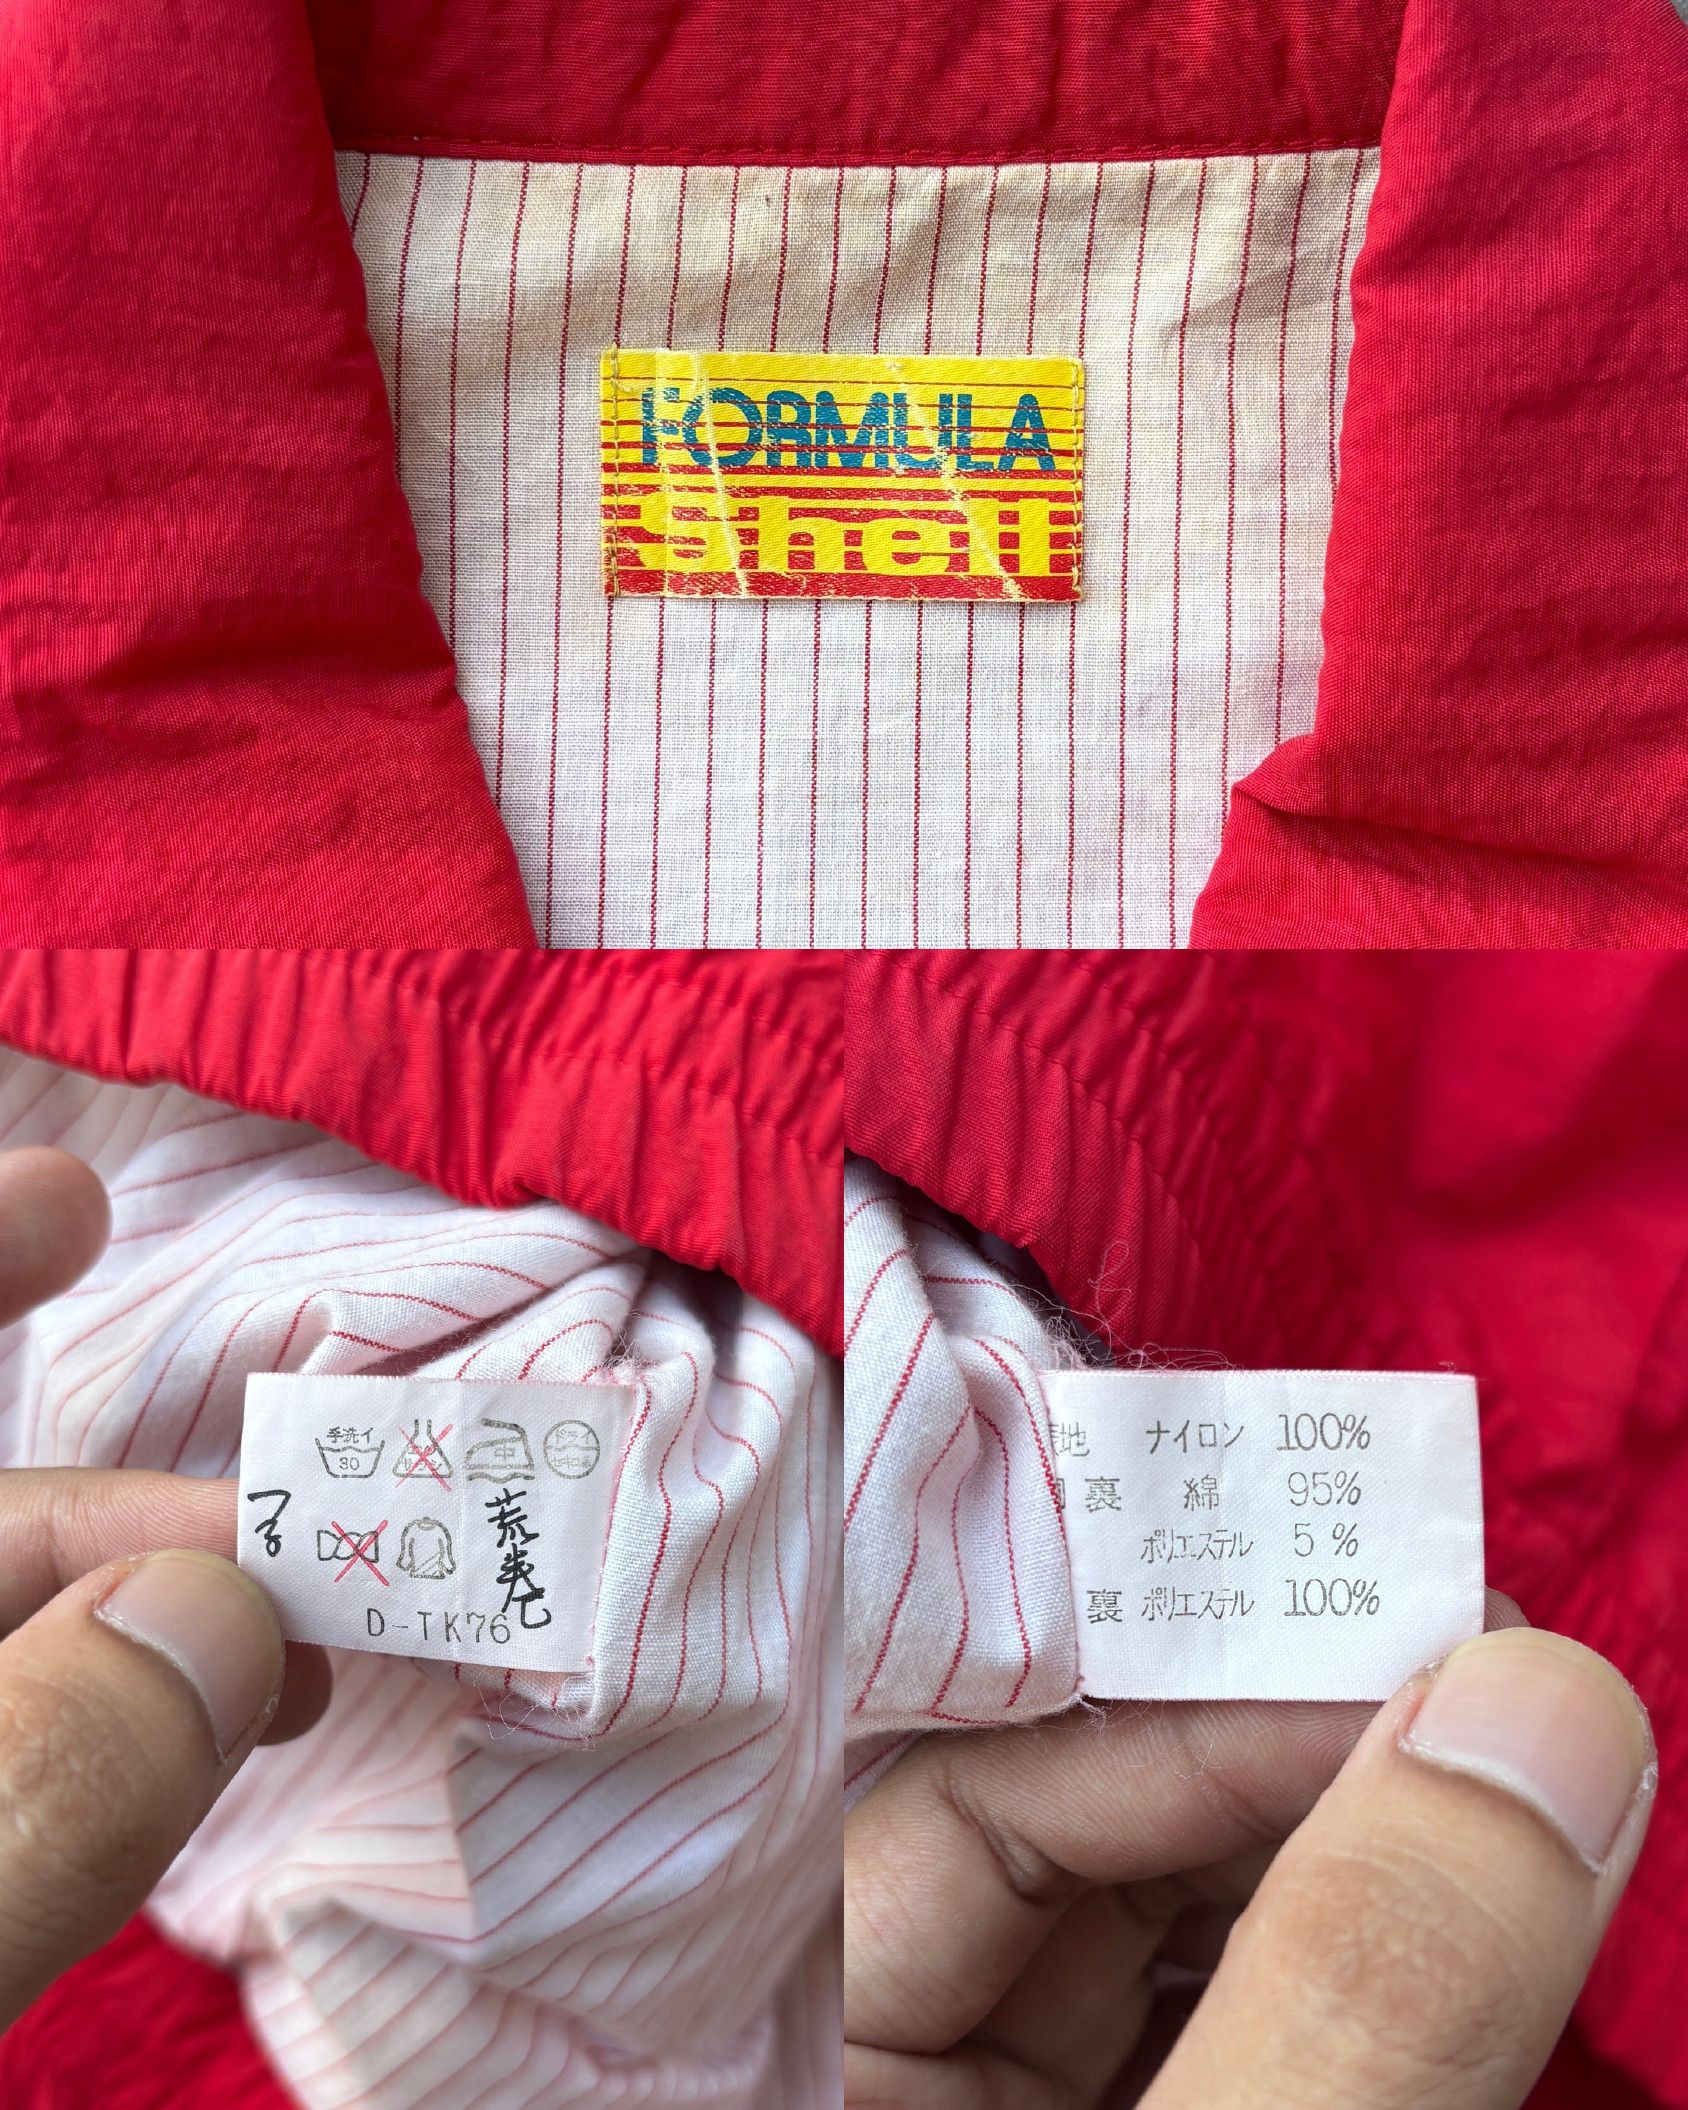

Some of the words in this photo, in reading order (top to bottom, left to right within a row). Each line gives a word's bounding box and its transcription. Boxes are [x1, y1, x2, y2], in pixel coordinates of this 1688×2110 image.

[641, 387, 1056, 472] FORMULA
[638, 494, 1052, 575] Shell
[327, 1426, 374, 1444] 手洗イ
[1146, 1420, 1244, 1454] ナイロン
[1277, 1413, 1370, 1451] 100%
[339, 1456, 360, 1470] 30
[1184, 1474, 1219, 1511] 綿
[1288, 1471, 1361, 1506] 95%
[1141, 1529, 1253, 1563] ポリエステル
[1087, 1589, 1122, 1623] 裏
[1141, 1587, 1254, 1621] ポリエステル
[1284, 1578, 1380, 1616] 100%
[367, 1608, 511, 1644] D-TK76
